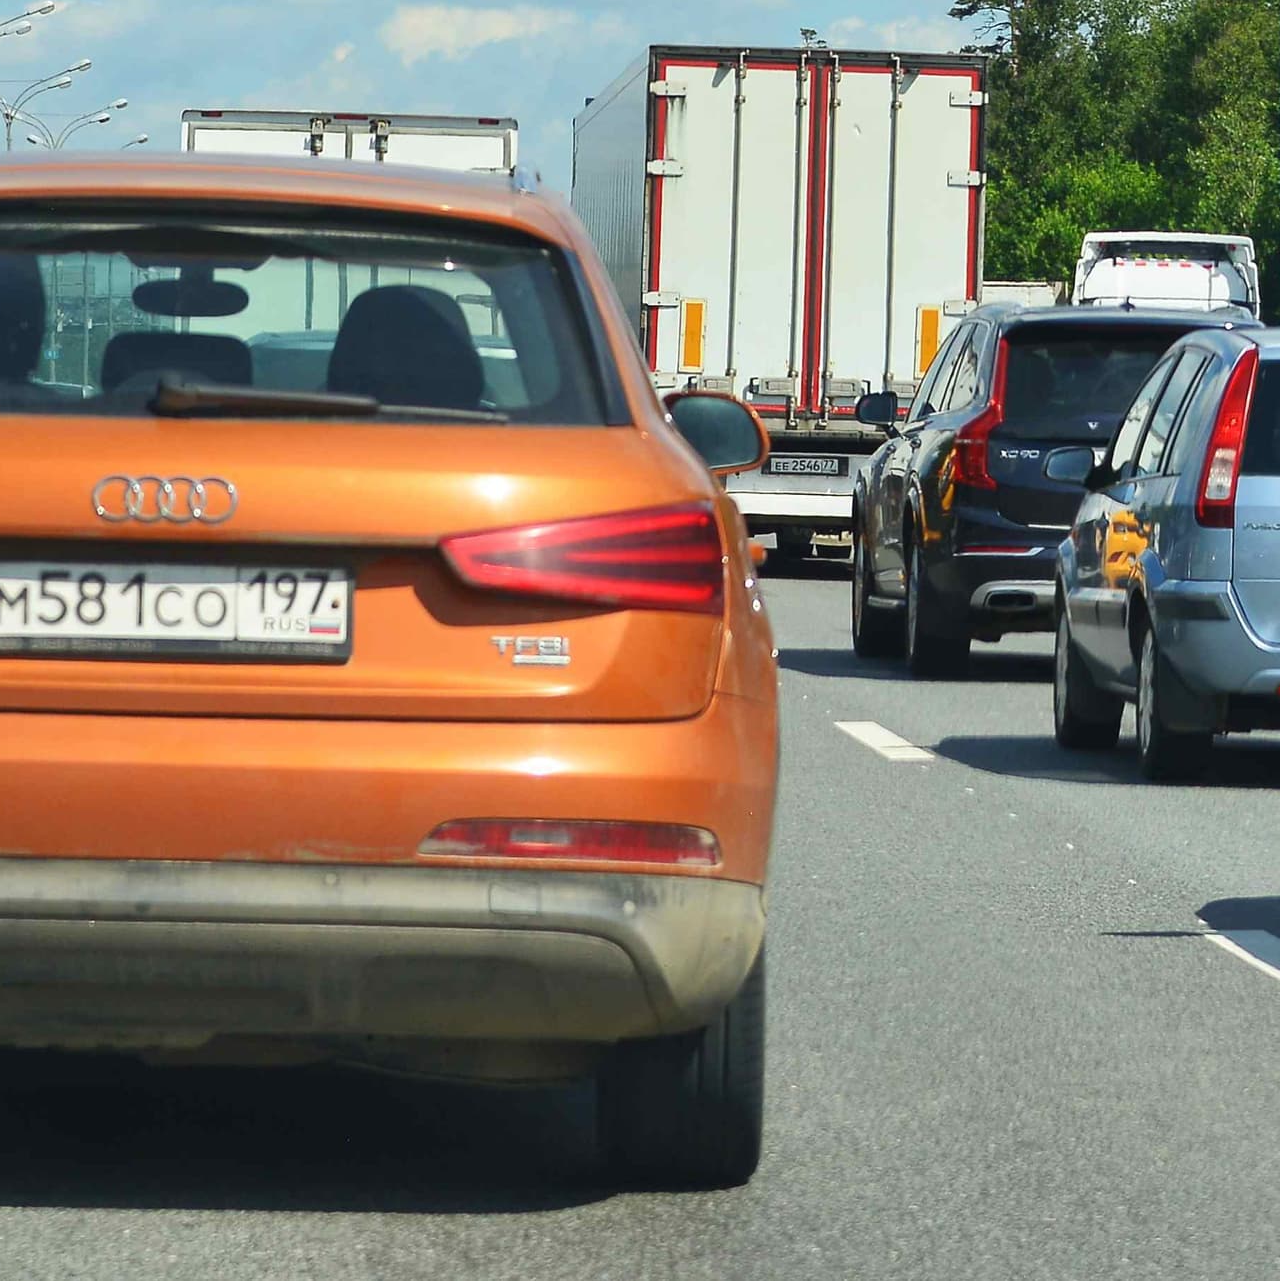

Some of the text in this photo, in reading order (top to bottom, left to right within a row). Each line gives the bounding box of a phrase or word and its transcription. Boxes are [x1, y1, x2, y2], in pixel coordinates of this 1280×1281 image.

[791, 460, 820, 472] 2546
[823, 459, 835, 469] 77
[246, 571, 332, 616] 197
[263, 616, 307, 632] RUS
